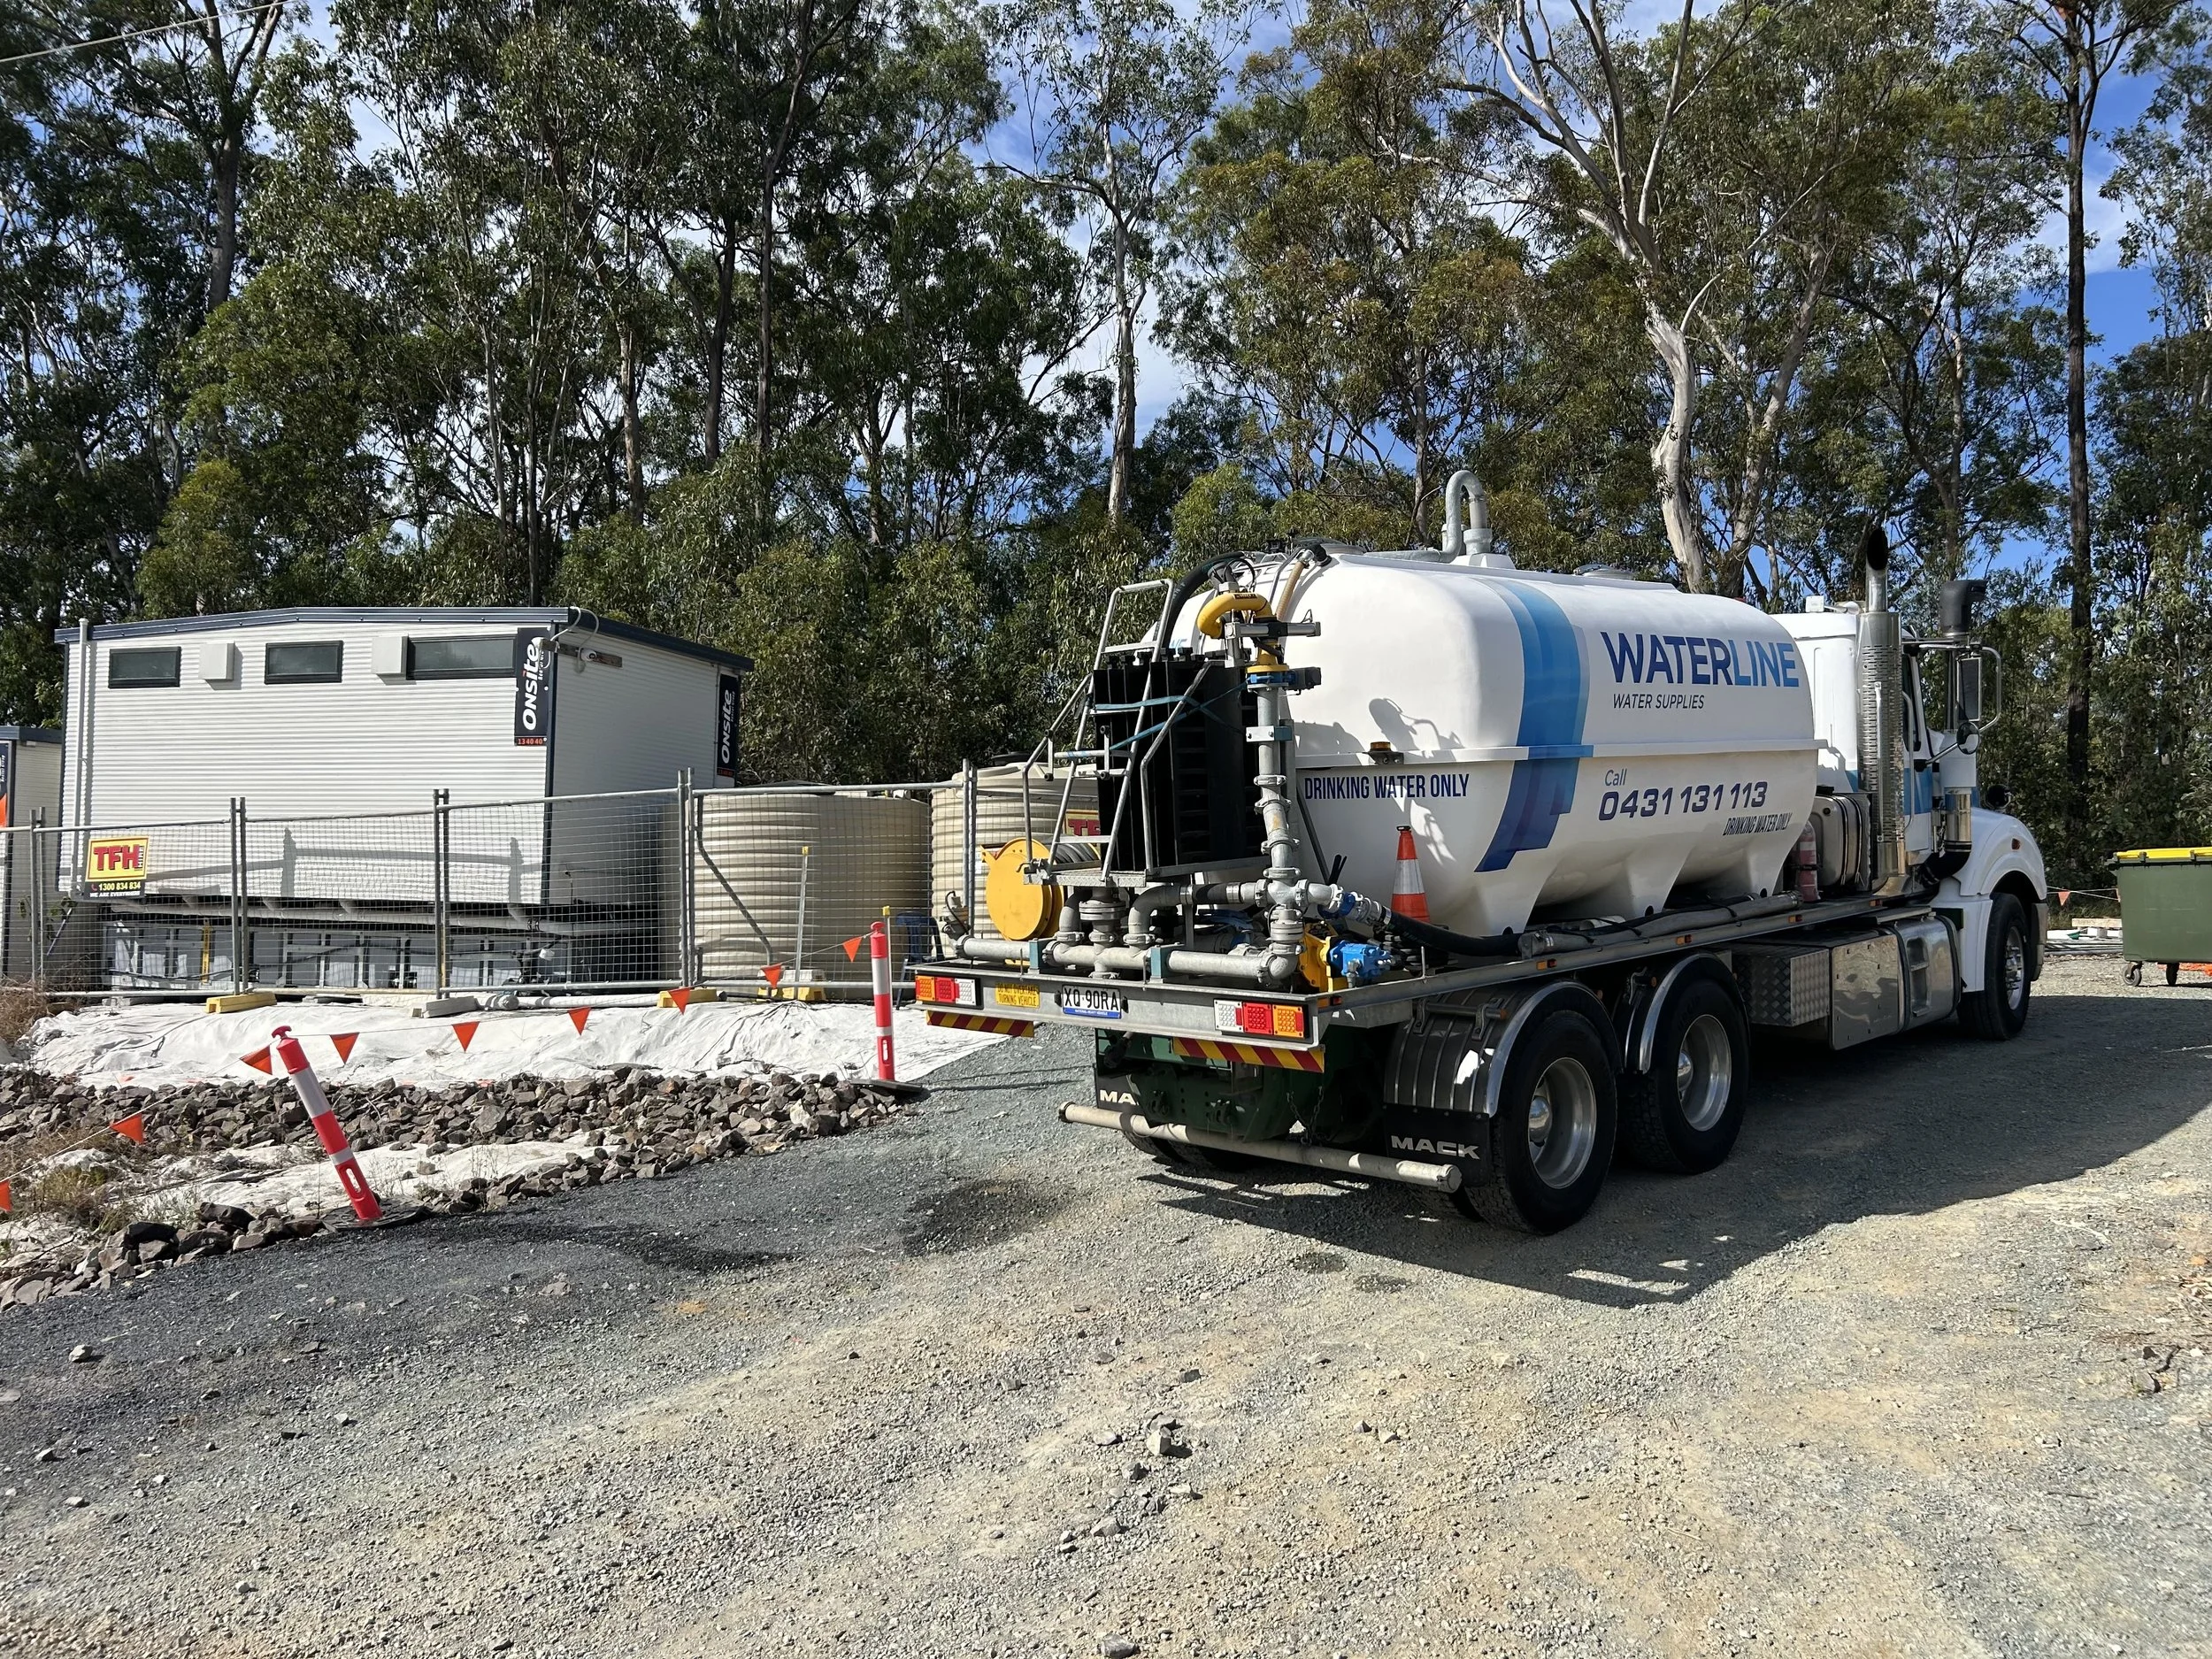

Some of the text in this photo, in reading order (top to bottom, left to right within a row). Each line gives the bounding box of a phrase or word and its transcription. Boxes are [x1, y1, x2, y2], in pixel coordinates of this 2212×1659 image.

[1600, 631, 1800, 687] WATERLINE
[1613, 693, 1705, 709] WATER SUPPLIES
[1304, 773, 1470, 800] DRINKING WATER ONLY
[1604, 768, 1628, 787] Call
[1598, 781, 1768, 821] 0431 131 113
[1722, 812, 1793, 836] DRINKING WATER ONLY
[94, 844, 139, 871] TFH
[98, 882, 115, 891] 1300
[998, 994, 1037, 1007] TURNING VEHICLE
[1100, 1089, 1139, 1105] MA
[1391, 1135, 1480, 1160] MACK
